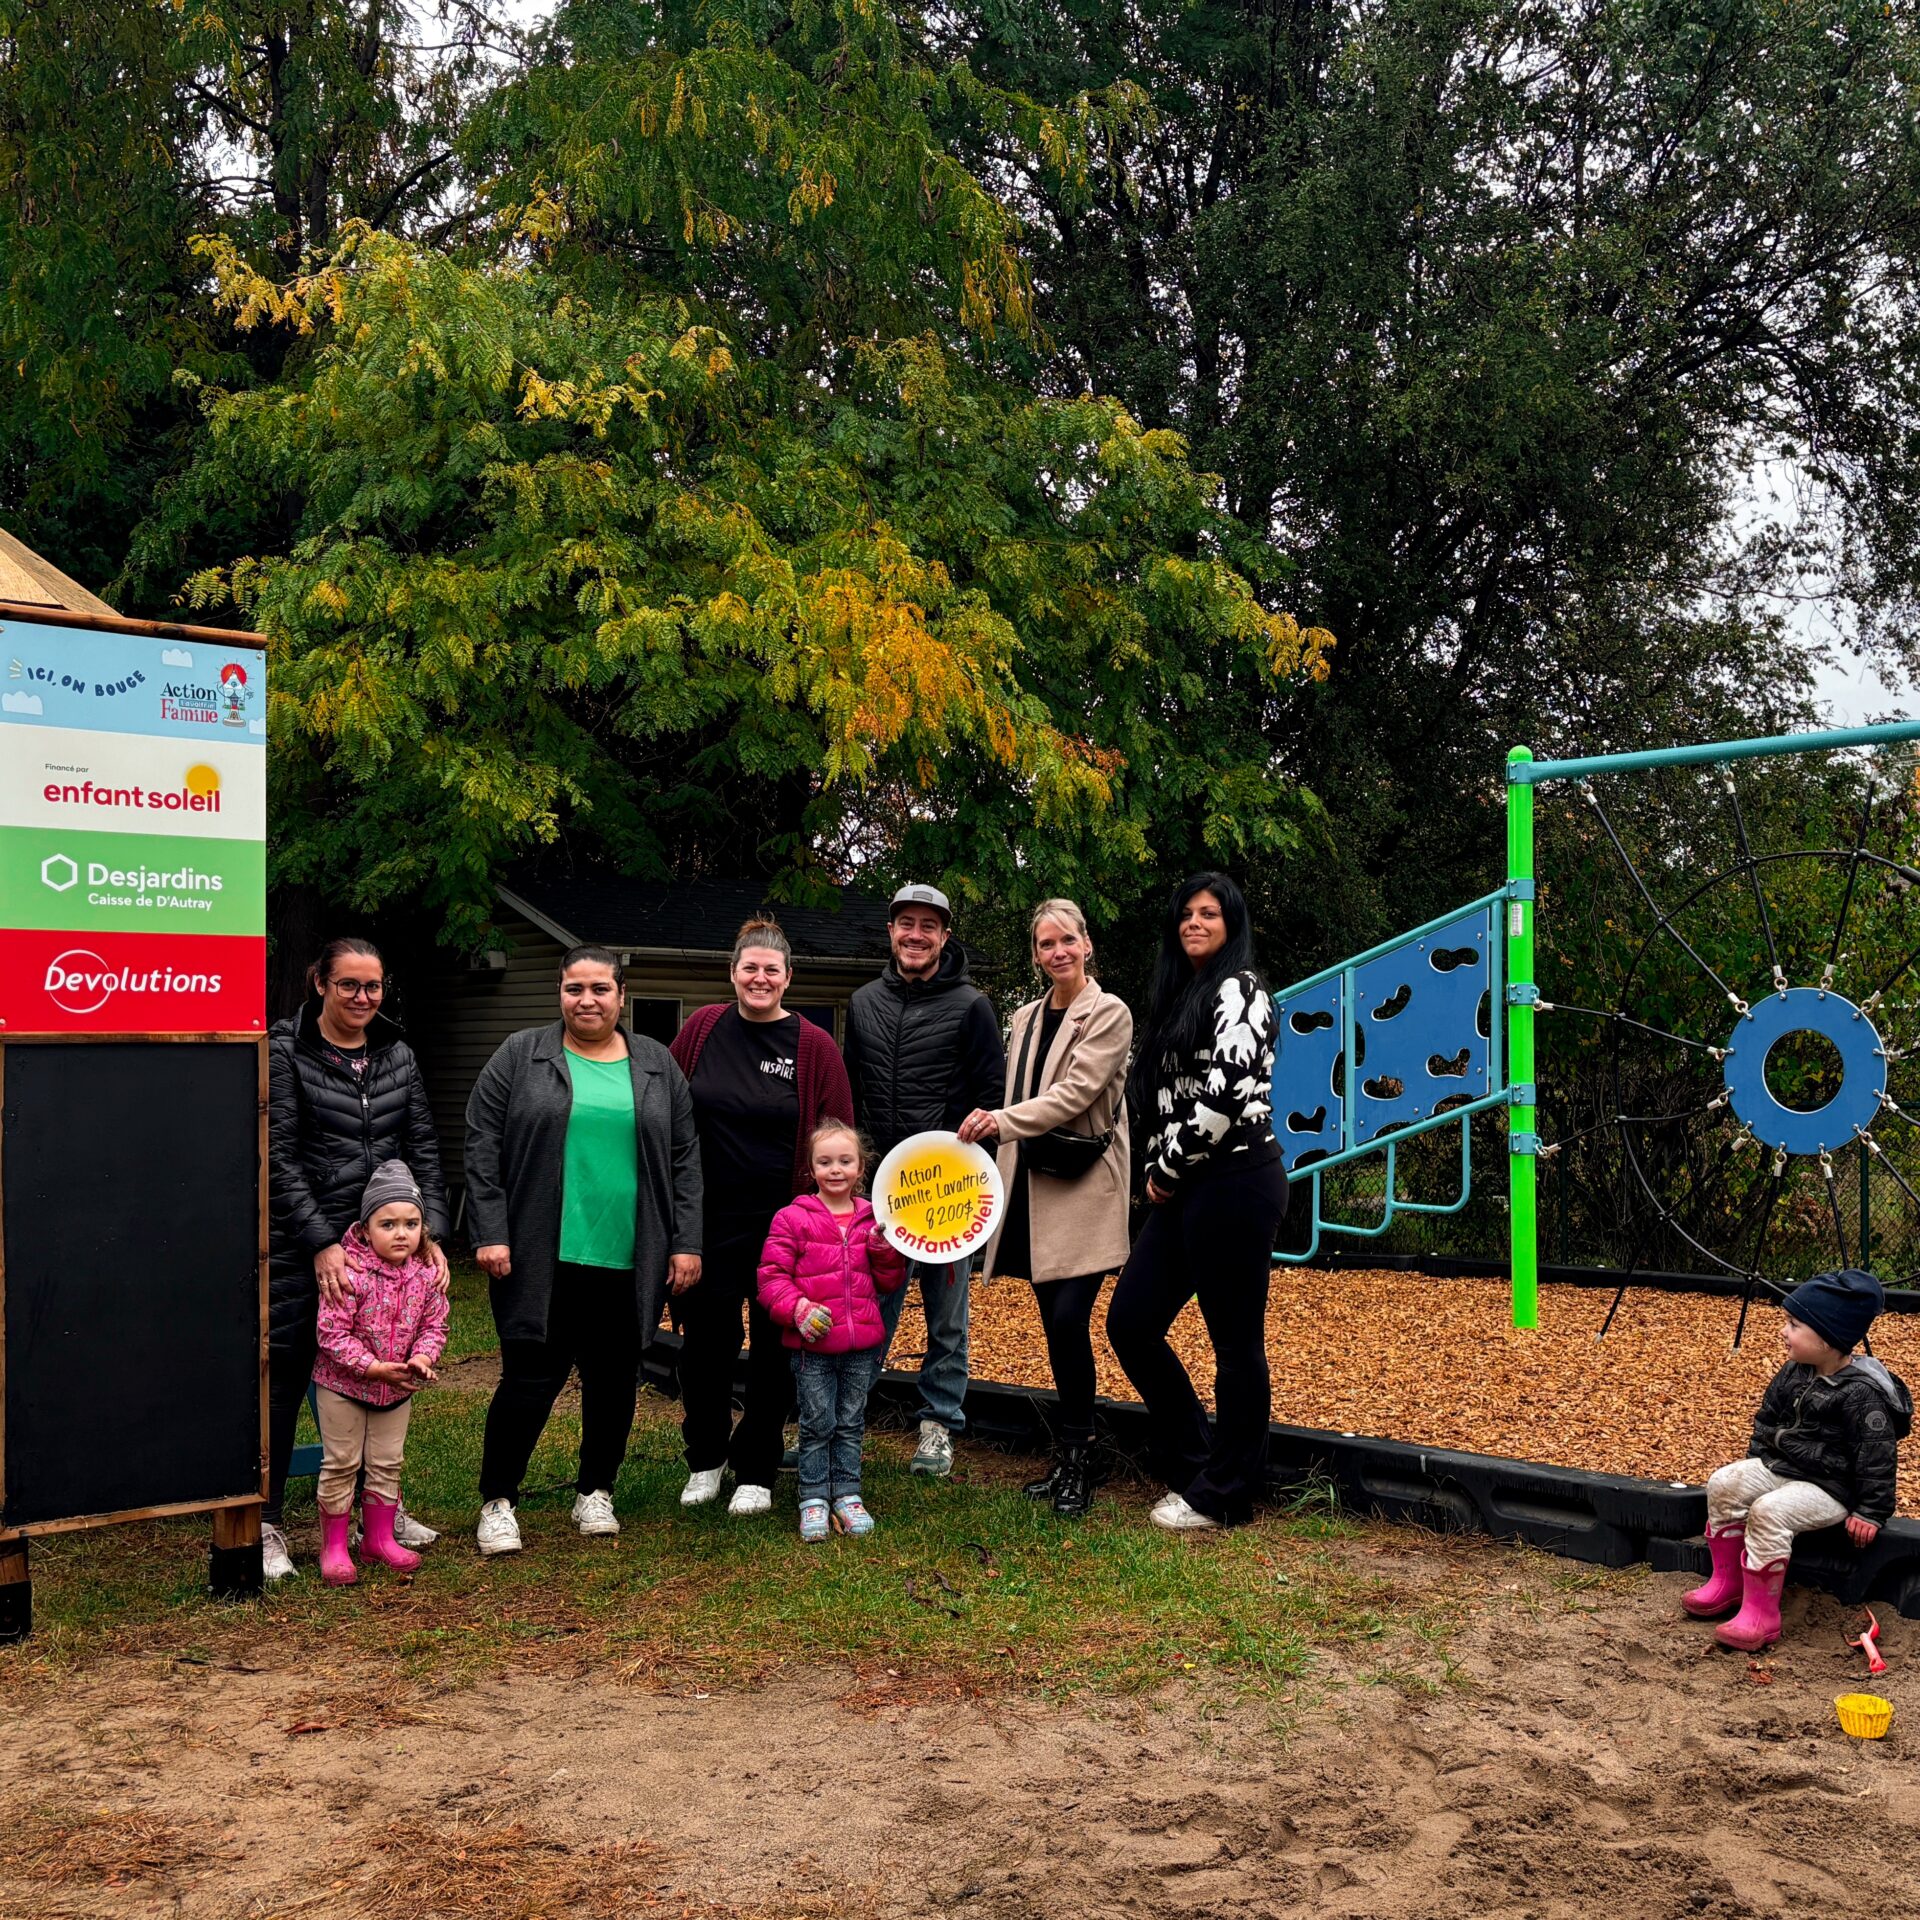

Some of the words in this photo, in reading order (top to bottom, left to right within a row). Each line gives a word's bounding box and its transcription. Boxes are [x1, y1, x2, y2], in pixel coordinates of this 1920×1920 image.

[61, 675, 86, 694] ON
[94, 669, 146, 697] BOUGE
[160, 682, 218, 701] Action
[160, 698, 218, 723] Famille
[45, 763, 75, 773] Financé
[75, 766, 89, 774] par
[43, 781, 144, 808] enfant
[147, 788, 221, 812] soleil
[88, 863, 223, 892] Desjardins
[88, 893, 132, 906] Caisse
[136, 894, 153, 907] de
[156, 895, 213, 911] D'Autray
[44, 966, 222, 993] Devolutions
[760, 1060, 795, 1079] INSPIRE
[900, 1163, 942, 1188] Action
[895, 1226, 962, 1253] enfant
[962, 1194, 994, 1243] soleil
[925, 1198, 974, 1230] 8200$
